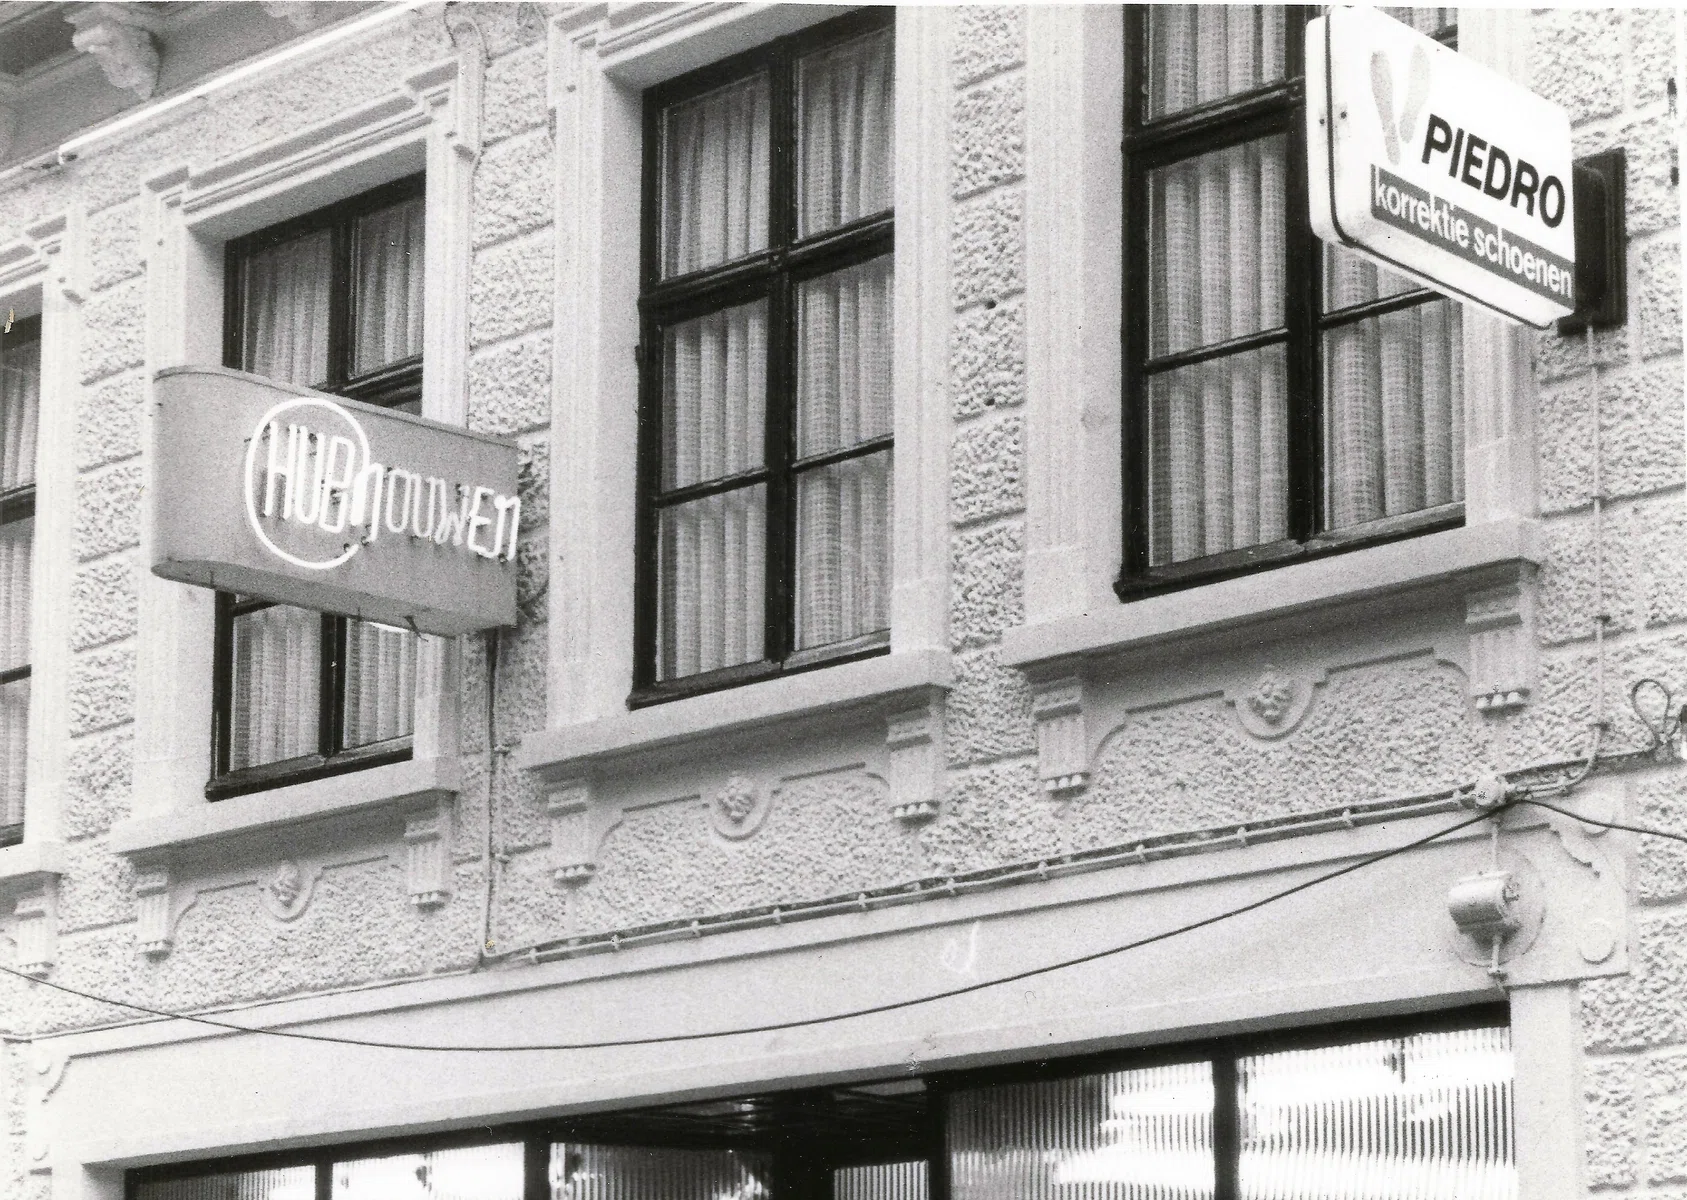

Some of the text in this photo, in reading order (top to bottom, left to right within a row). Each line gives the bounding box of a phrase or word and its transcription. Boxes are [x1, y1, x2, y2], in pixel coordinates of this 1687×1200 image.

[1374, 167, 1573, 299] korrektie schoenen
[1421, 114, 1566, 229] PIEDRO
